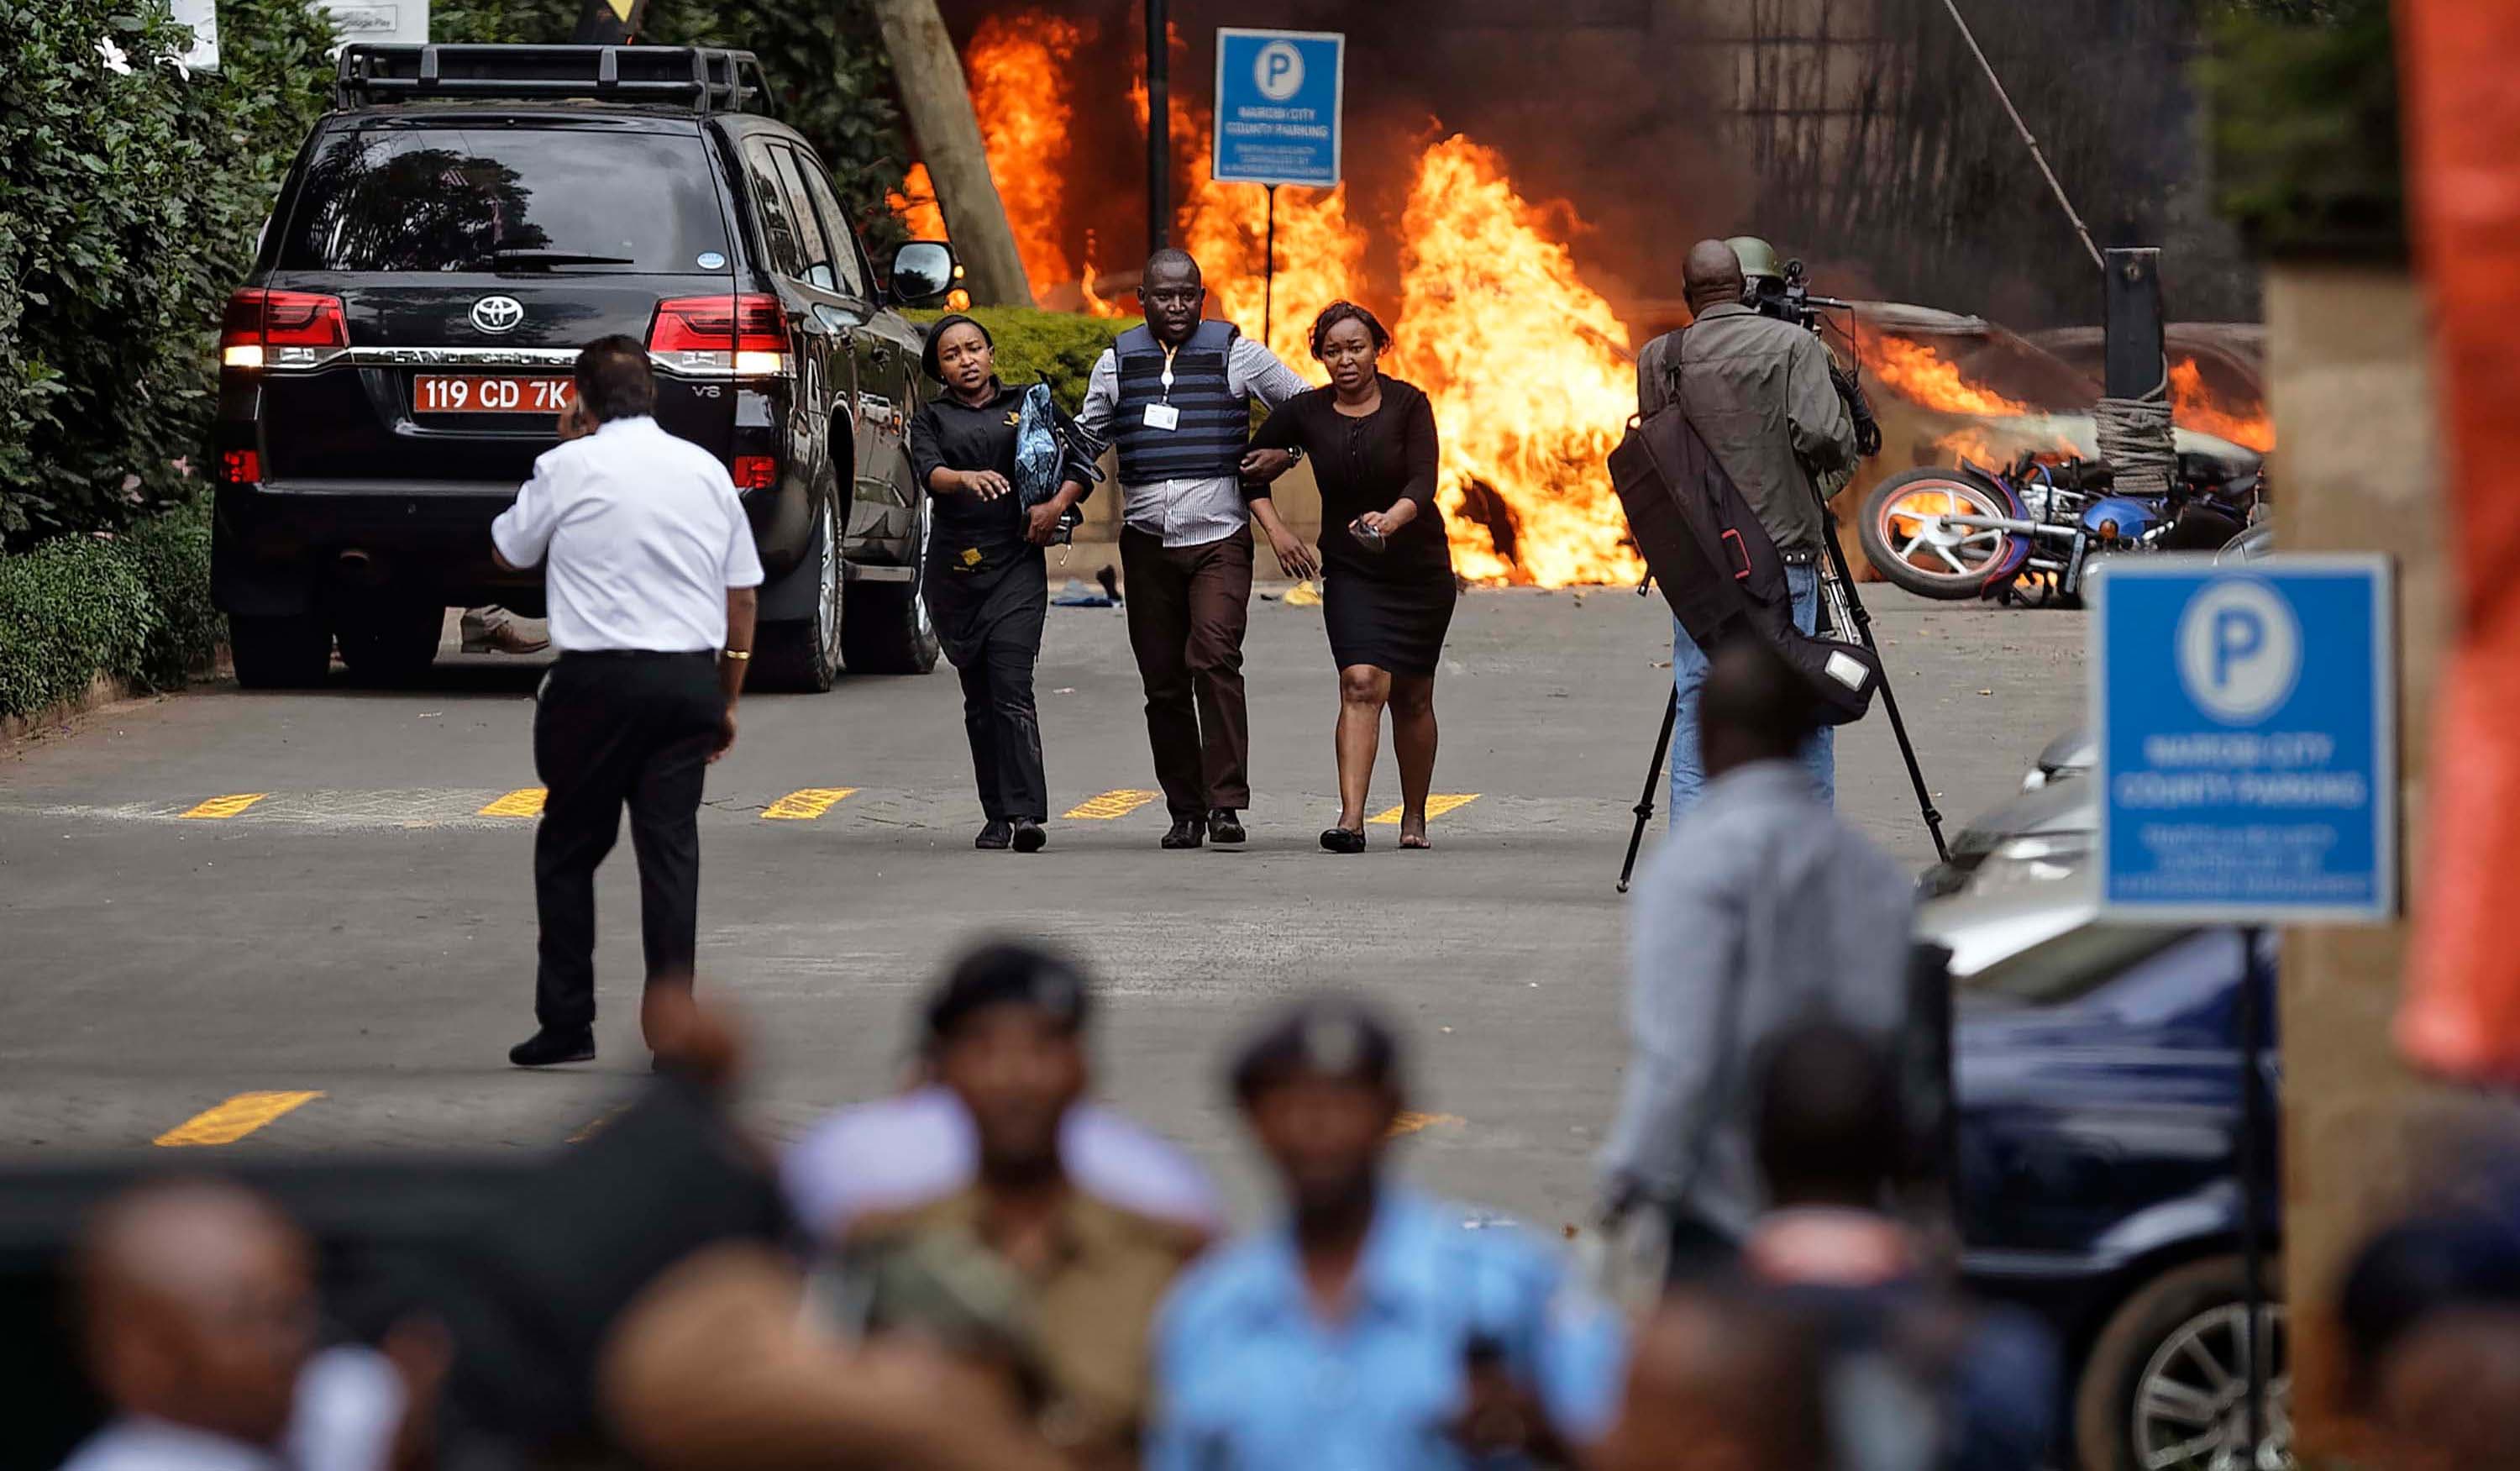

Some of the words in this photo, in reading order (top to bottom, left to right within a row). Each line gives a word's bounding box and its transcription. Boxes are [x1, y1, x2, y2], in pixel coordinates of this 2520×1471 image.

[1267, 53, 1291, 87] P
[1288, 108, 1317, 120] CITY
[425, 380, 469, 407] 119
[480, 380, 520, 408] CD
[529, 381, 570, 409] 7K
[692, 386, 722, 398] V8
[2213, 608, 2265, 690] P
